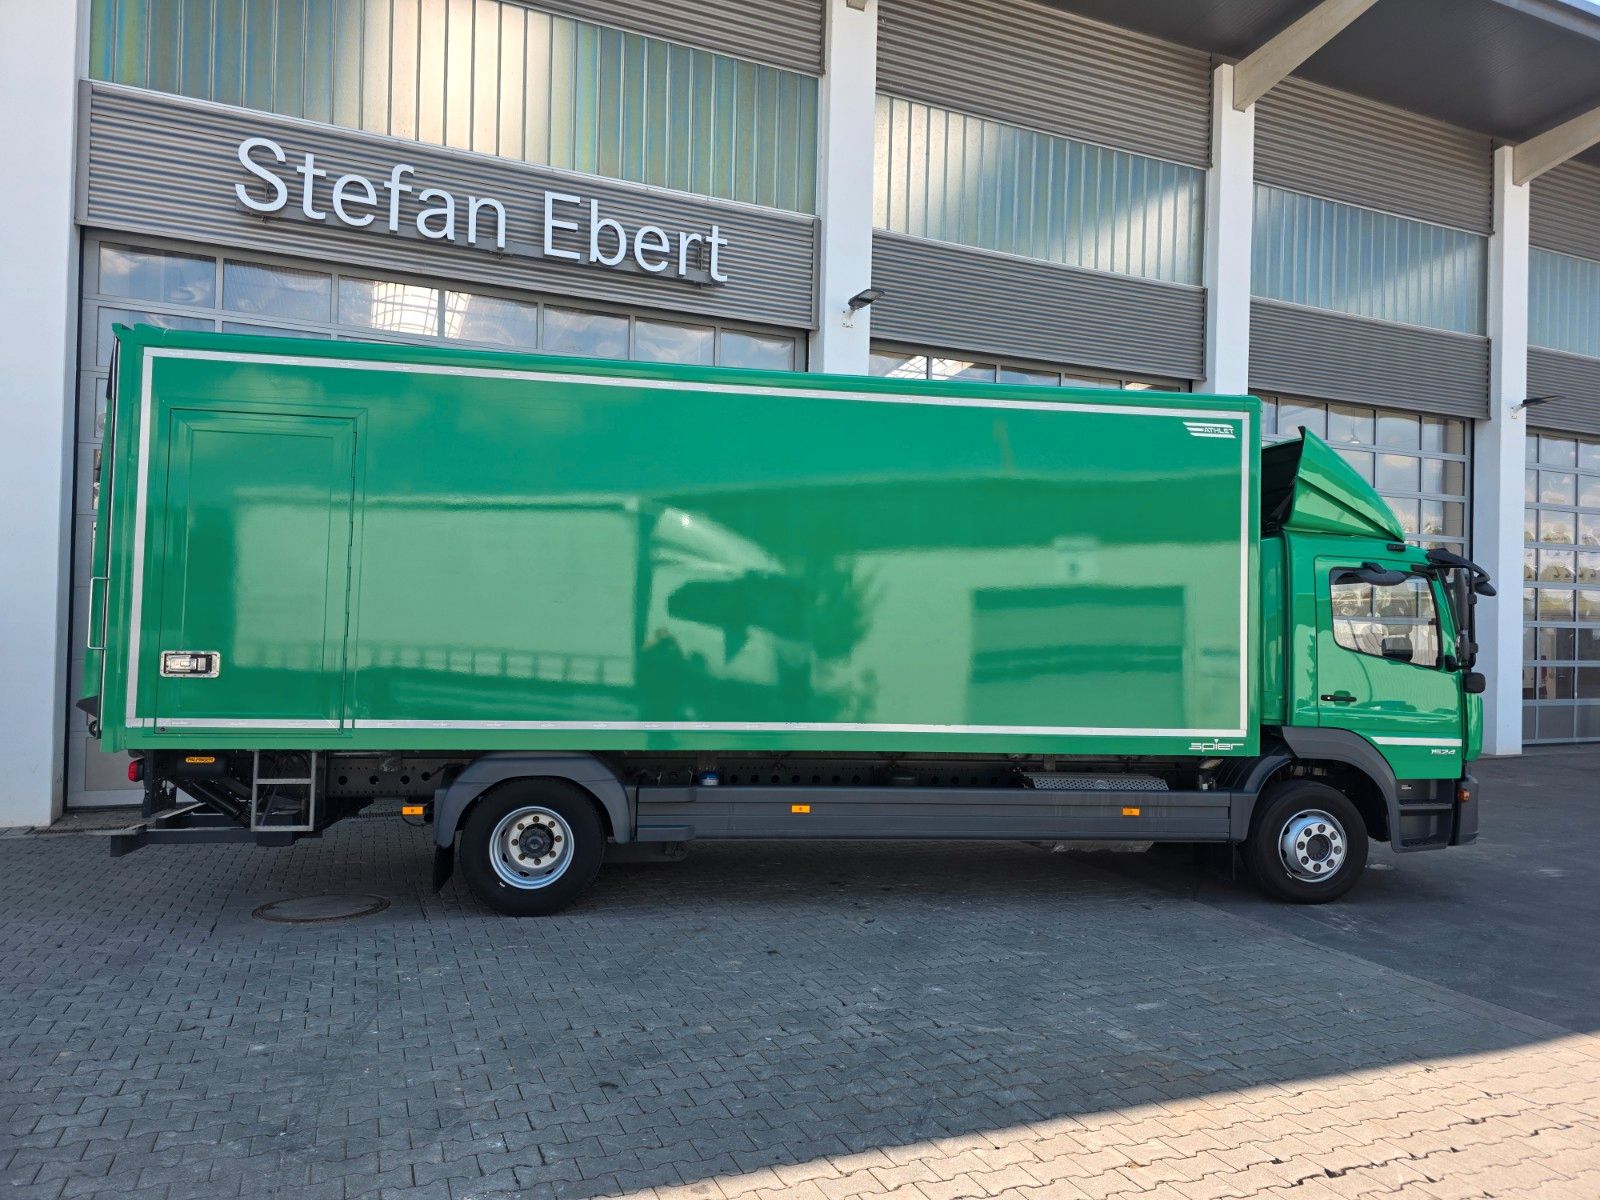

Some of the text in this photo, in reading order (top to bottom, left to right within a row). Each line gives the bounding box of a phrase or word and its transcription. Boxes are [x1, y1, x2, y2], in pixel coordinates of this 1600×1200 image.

[234, 137, 729, 283] Stefan Ebert
[1188, 738, 1245, 753] spier
